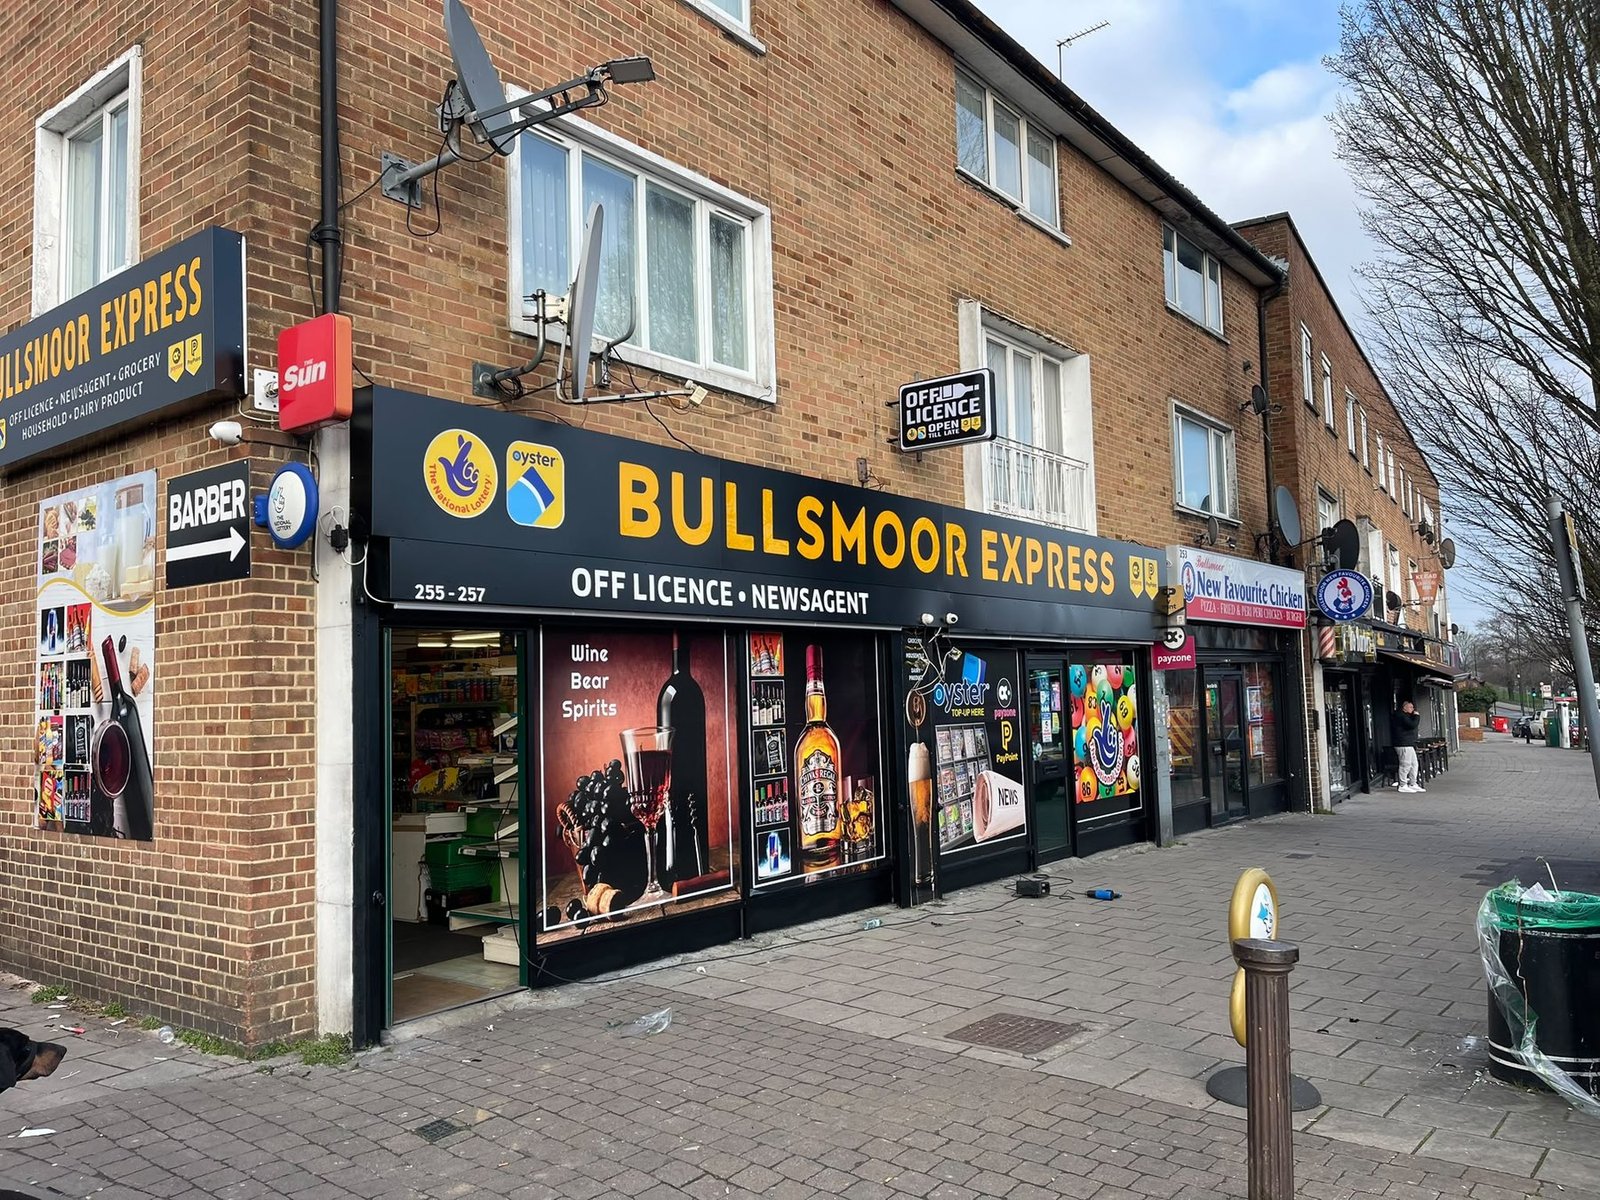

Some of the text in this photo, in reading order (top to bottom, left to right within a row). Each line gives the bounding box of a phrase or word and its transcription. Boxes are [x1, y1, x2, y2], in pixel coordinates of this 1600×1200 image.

[101, 256, 202, 355] EXPRESS
[283, 361, 326, 391] Sun
[9, 351, 161, 427] OFF LICENCE NEWSAGENT GROCERY
[906, 387, 939, 408] OFF
[22, 381, 143, 440] HOUSEHOLD DAIRY PRODUCT
[906, 397, 980, 425] LICENCE
[928, 419, 960, 433] OPEN
[944, 429, 960, 437] LATE
[512, 450, 556, 468] oyster
[428, 463, 493, 514] The National Lottery
[169, 479, 246, 535] BARBER
[619, 461, 1115, 597] BULLSMOOR EXPRESS
[1325, 573, 1338, 583] NEW
[414, 583, 447, 600] 255
[457, 585, 486, 602] 257
[571, 567, 869, 615] OFF LICENCE NEWSAGENT
[1197, 570, 1304, 609] New Favourite Chicken
[1200, 600, 1217, 613] PIZZA
[1220, 602, 1236, 615] FRIED
[571, 643, 609, 662] Wine
[1157, 654, 1192, 665] payzone
[570, 672, 609, 689] Bear
[933, 677, 987, 714] oyster
[562, 699, 617, 722] Spirits
[951, 707, 985, 717] TOP-UP HERE
[996, 753, 1019, 764] PayPoint
[998, 787, 1019, 807] NEWS
